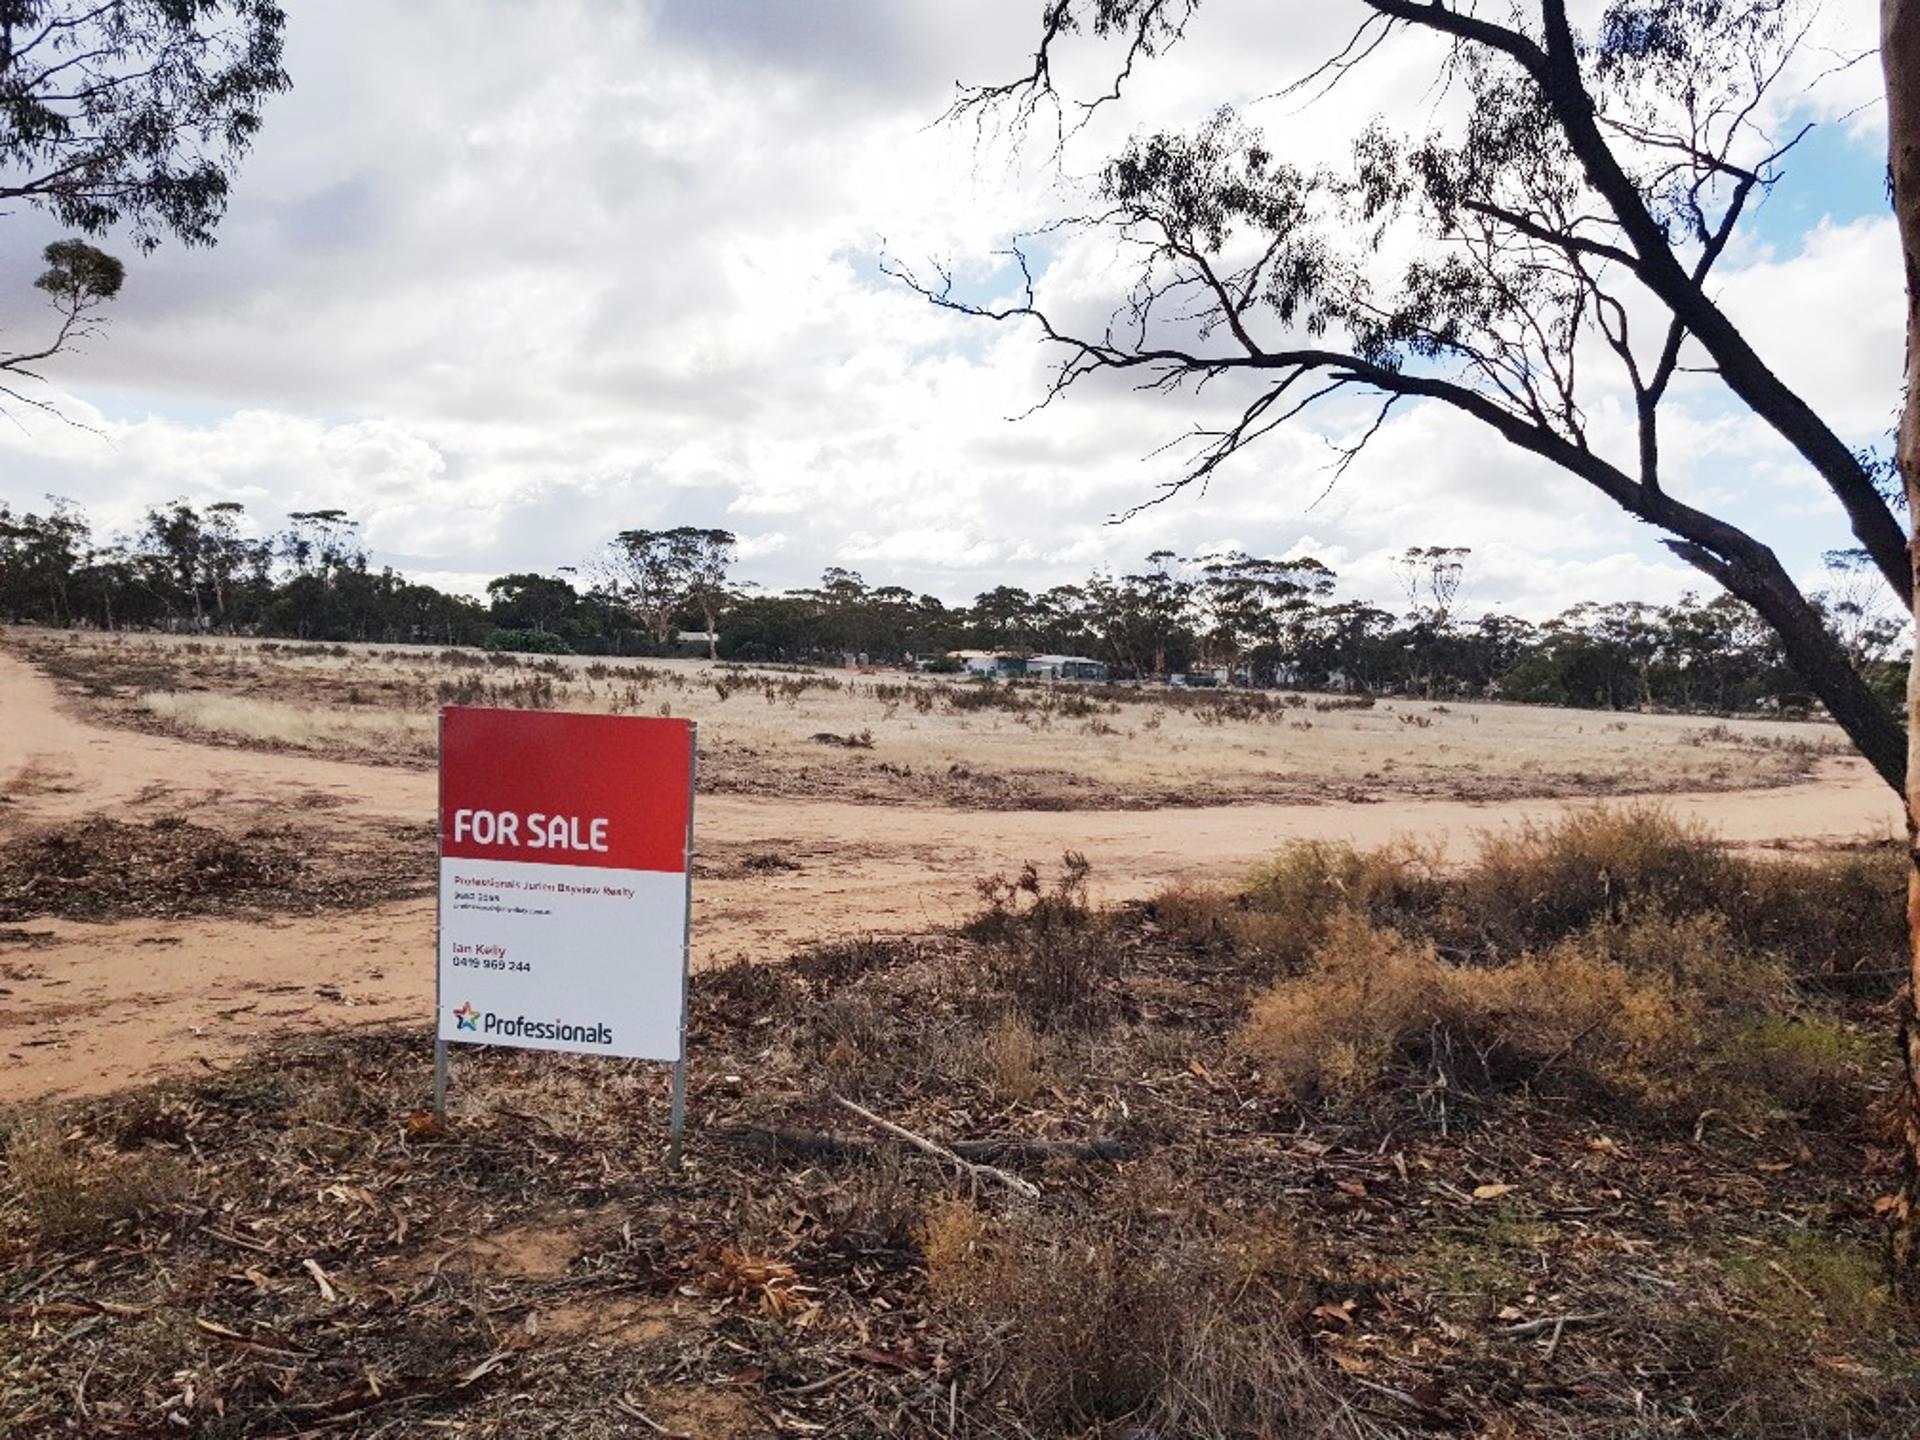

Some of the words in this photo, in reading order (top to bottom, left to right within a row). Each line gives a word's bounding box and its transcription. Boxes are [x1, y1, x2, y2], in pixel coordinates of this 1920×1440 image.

[454, 809, 520, 847] FOR
[527, 813, 609, 852] SALE
[452, 942, 471, 954] Ian
[475, 944, 506, 958] Kelly
[452, 956, 480, 968] 0419
[509, 961, 531, 972] 244
[484, 1013, 613, 1044] Professionals
